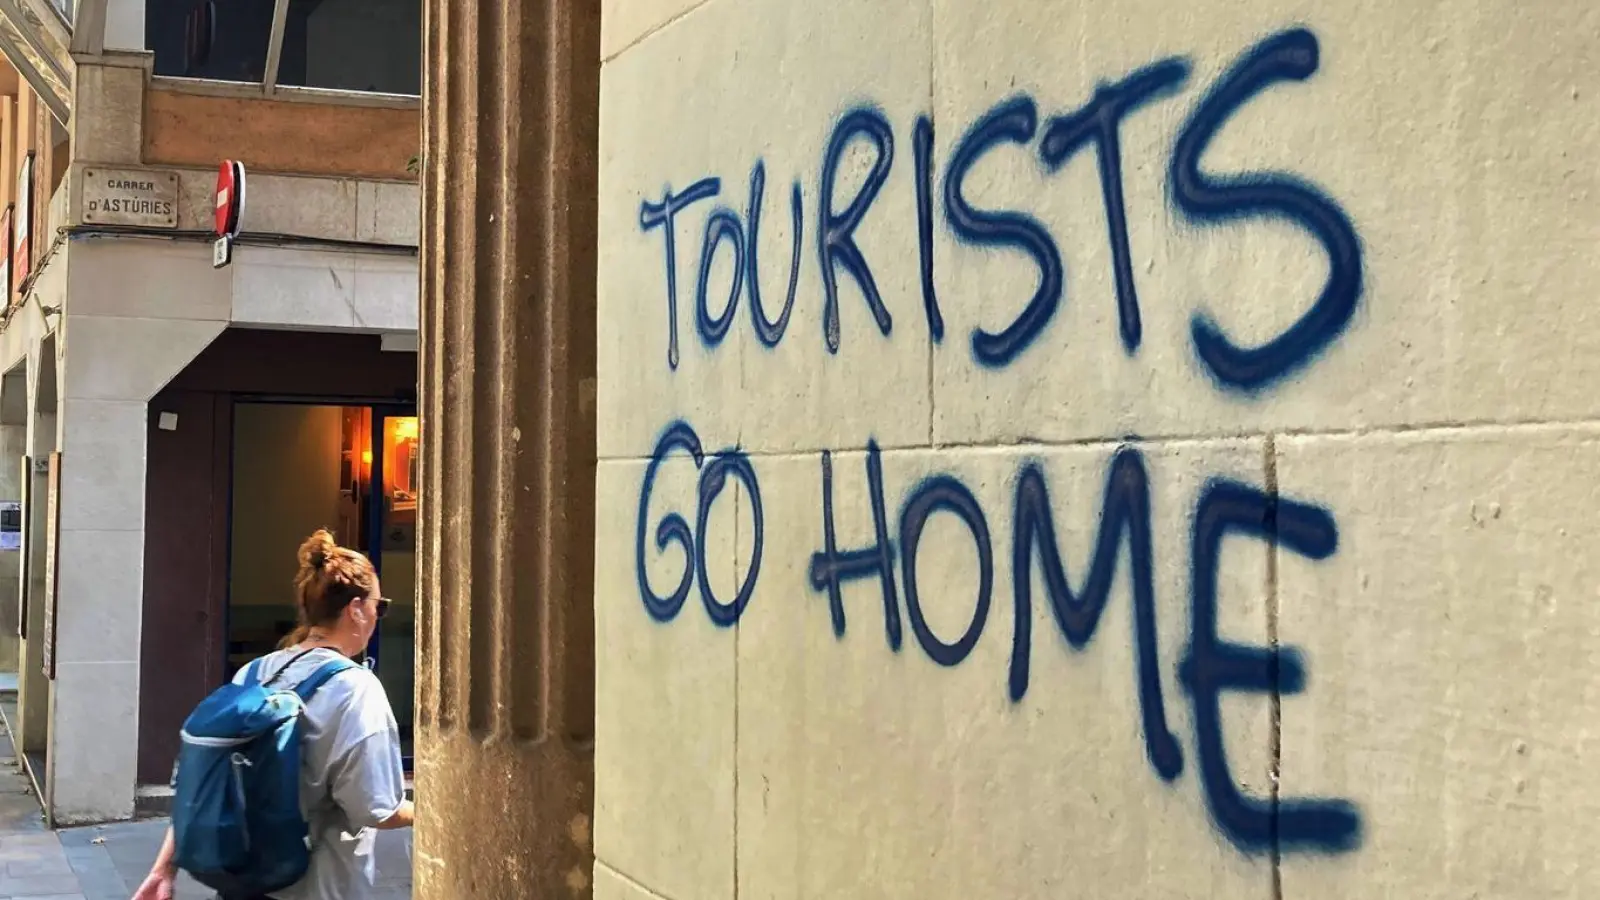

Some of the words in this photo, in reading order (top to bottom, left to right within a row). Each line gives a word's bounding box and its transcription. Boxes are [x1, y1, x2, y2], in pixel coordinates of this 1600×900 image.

[107, 180, 154, 190] CARRER
[639, 27, 1363, 394] TOURISTS
[636, 419, 764, 627] GO
[809, 438, 1362, 855] HOME
